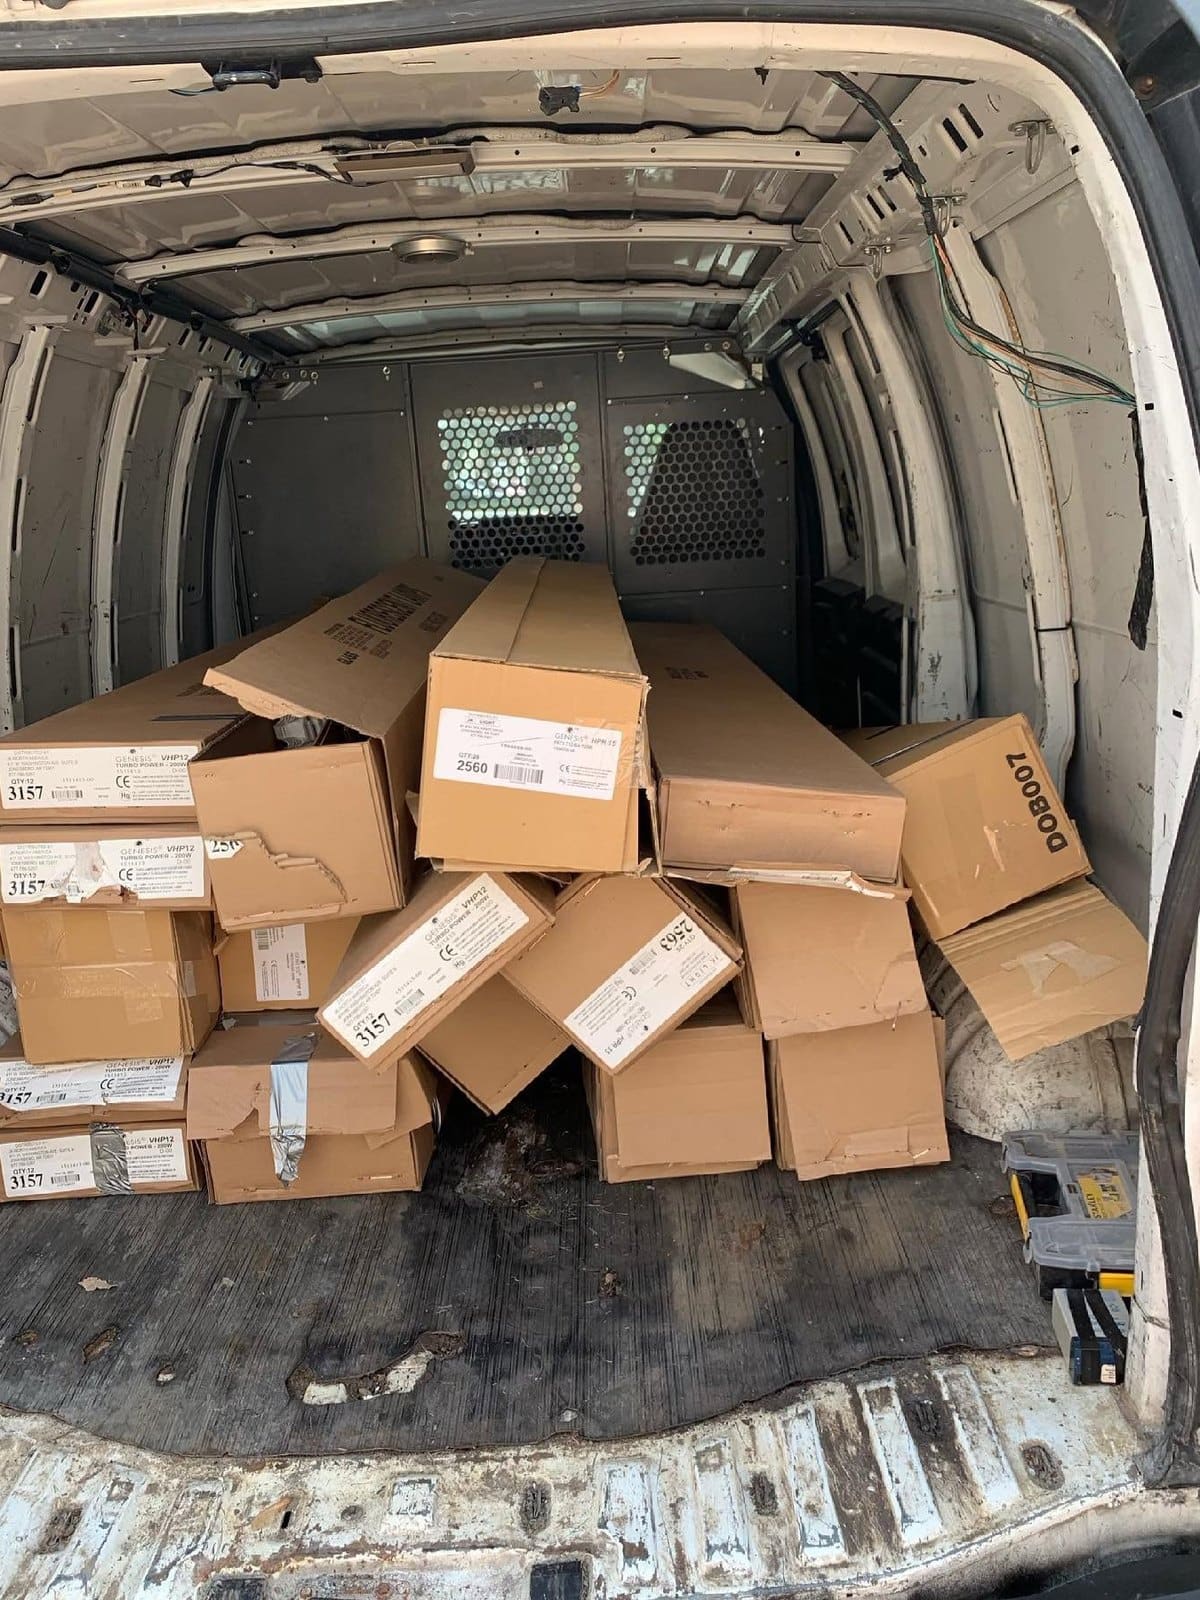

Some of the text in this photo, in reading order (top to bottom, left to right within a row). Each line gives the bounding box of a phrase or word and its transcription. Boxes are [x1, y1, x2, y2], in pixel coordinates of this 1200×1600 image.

[456, 759, 488, 774] 2560
[8, 785, 43, 801] 3157
[1005, 752, 1069, 854] DOB007
[8, 880, 45, 896] 3157
[461, 886, 488, 909] VHP12
[659, 918, 693, 952] 2563
[353, 1012, 375, 1032] QTY:12
[355, 1012, 392, 1048] 3157
[149, 1057, 175, 1065] VHP12
[149, 1135, 175, 1143] VHP12
[10, 1173, 43, 1189] 3157
